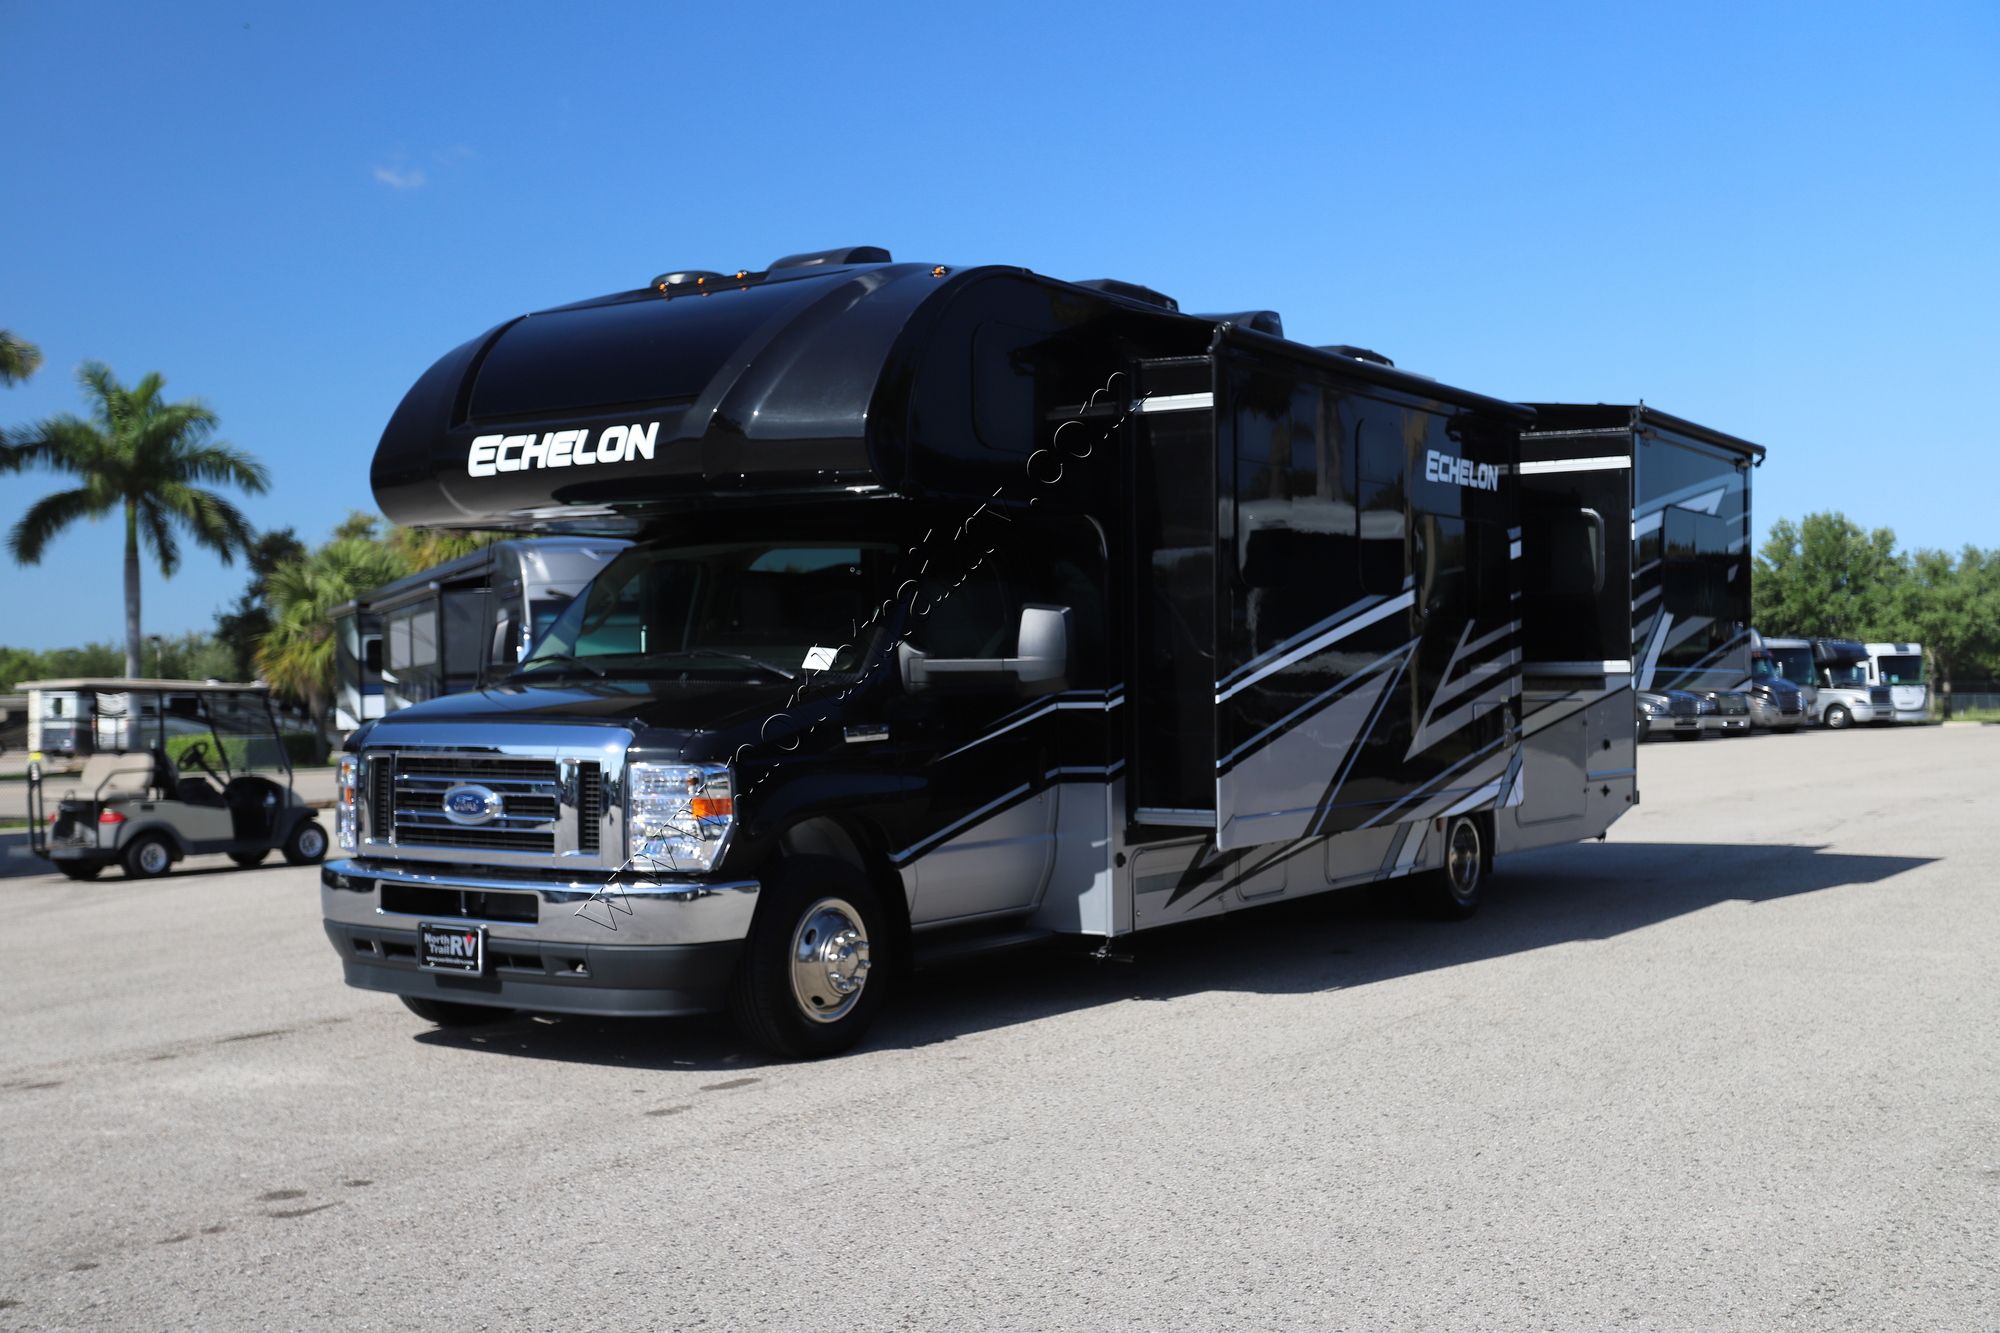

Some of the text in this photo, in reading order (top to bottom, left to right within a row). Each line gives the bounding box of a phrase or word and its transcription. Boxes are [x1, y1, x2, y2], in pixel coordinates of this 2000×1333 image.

[468, 422, 660, 477] ECHELON
[1425, 449, 1499, 492] ECHELON
[424, 932, 450, 944] North
[429, 943, 450, 955] Trail
[450, 935, 477, 957] RV
